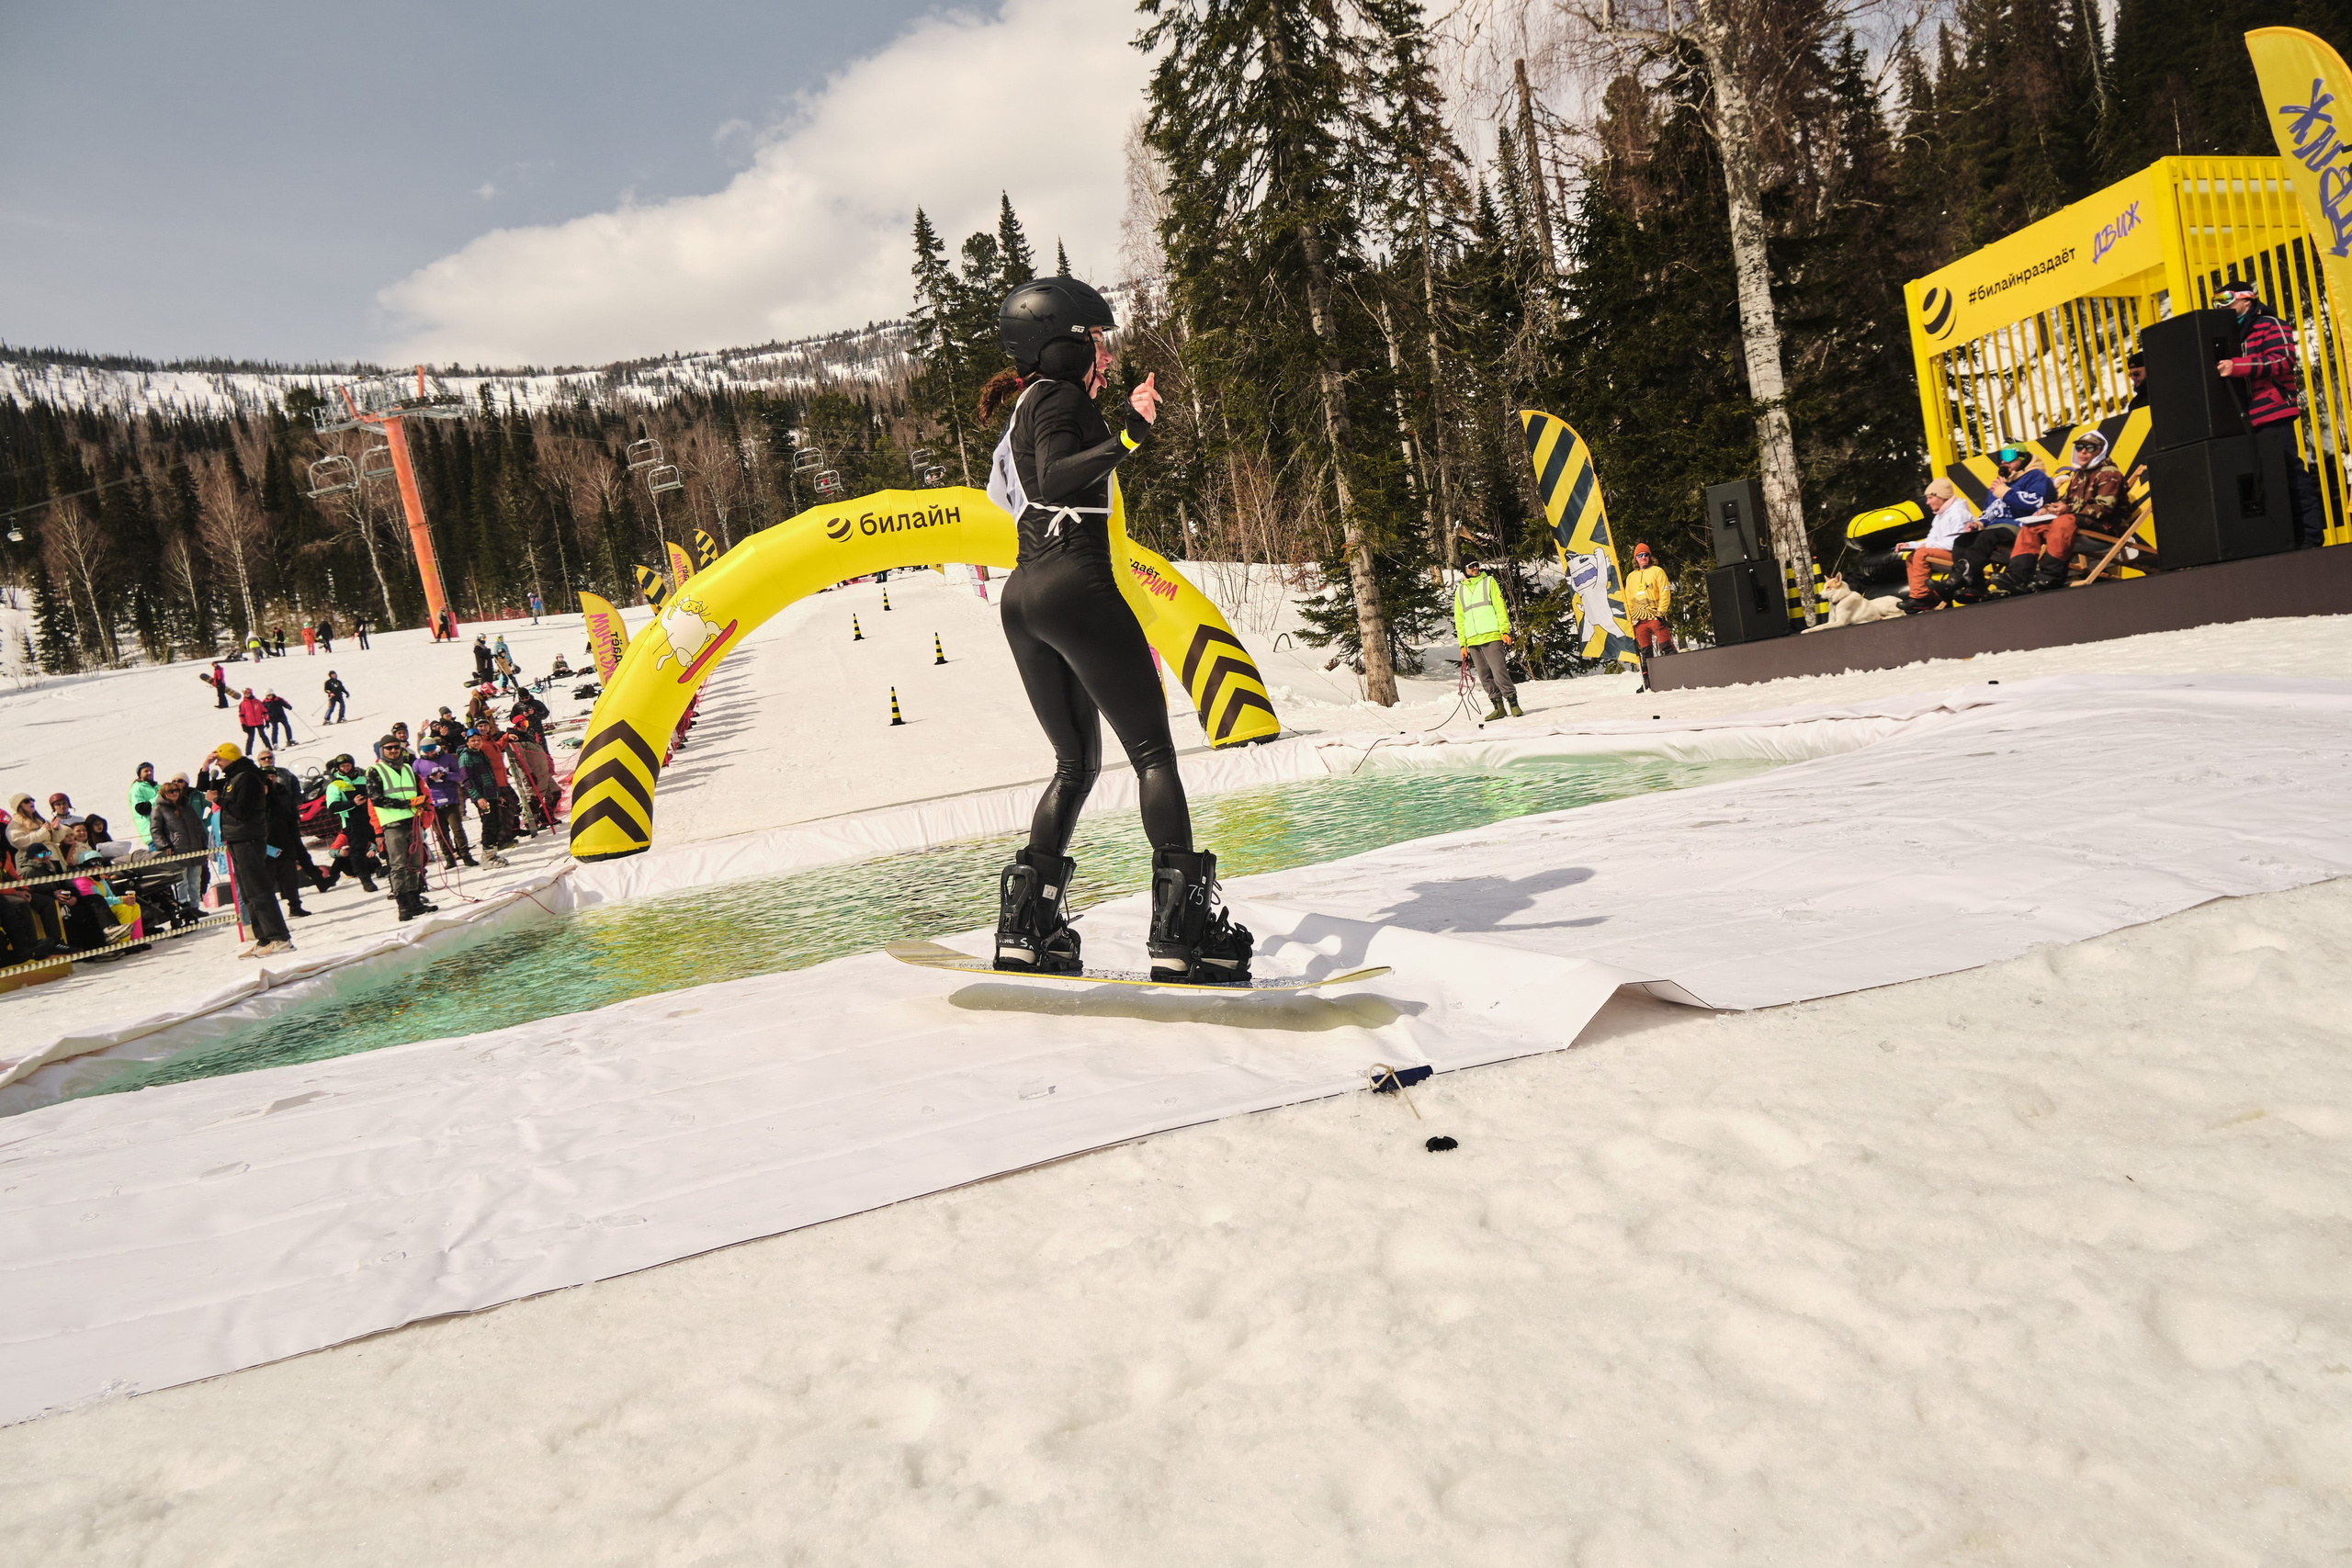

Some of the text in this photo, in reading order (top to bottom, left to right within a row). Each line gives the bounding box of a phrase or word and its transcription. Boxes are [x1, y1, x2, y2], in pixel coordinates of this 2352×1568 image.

[1968, 199, 2143, 305] #билайнраздаёт ДВИЖ
[859, 504, 961, 536] билайн
[1188, 884, 1205, 906] 75
